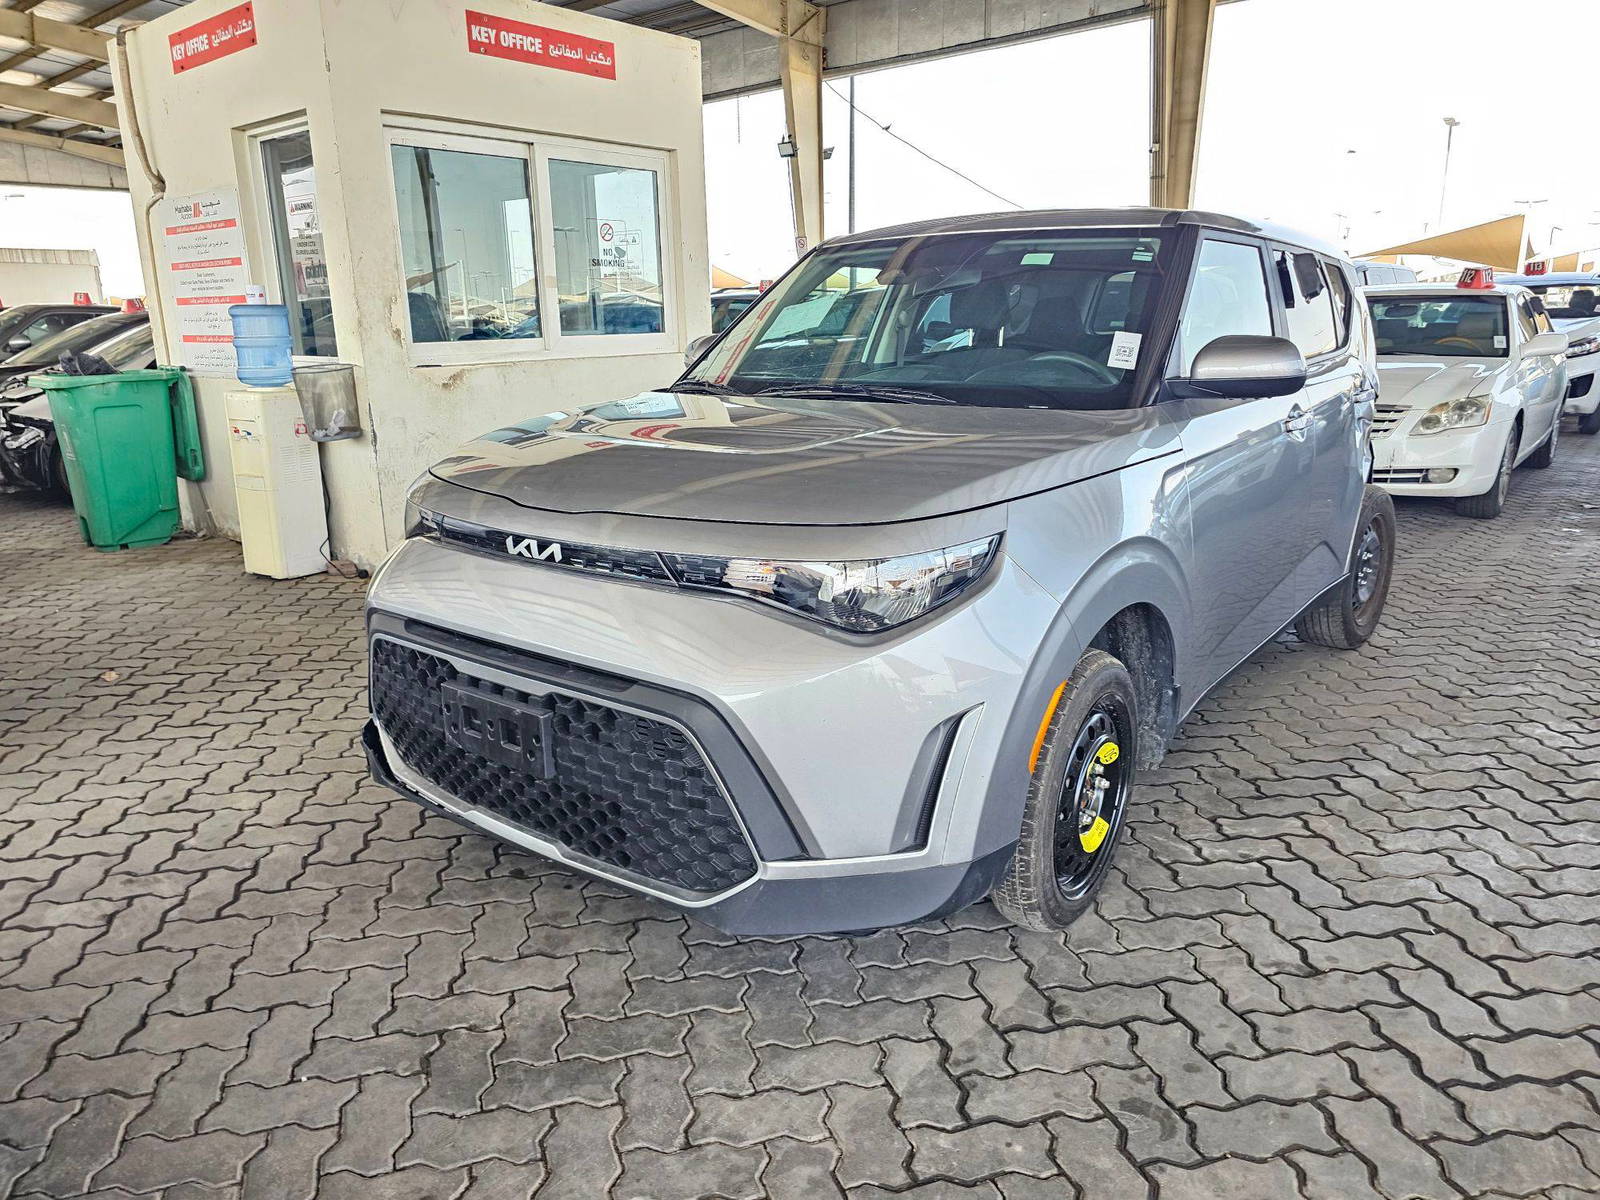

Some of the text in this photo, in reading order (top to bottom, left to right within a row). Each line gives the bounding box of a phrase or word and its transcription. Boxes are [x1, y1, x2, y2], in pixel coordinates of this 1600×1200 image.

[211, 18, 253, 47] مكتب المفاتيح
[471, 24, 543, 54] KEY OFFICE
[172, 33, 210, 62] KEY OFFICE
[549, 44, 612, 66] مكتب المفاتيح
[294, 201, 313, 212] WARNING
[603, 248, 613, 257] NO
[591, 258, 625, 268] SMOKING
[1530, 262, 1543, 272] 113
[1460, 269, 1475, 283] 112
[1483, 270, 1492, 283] 112
[506, 535, 563, 563] KIA
